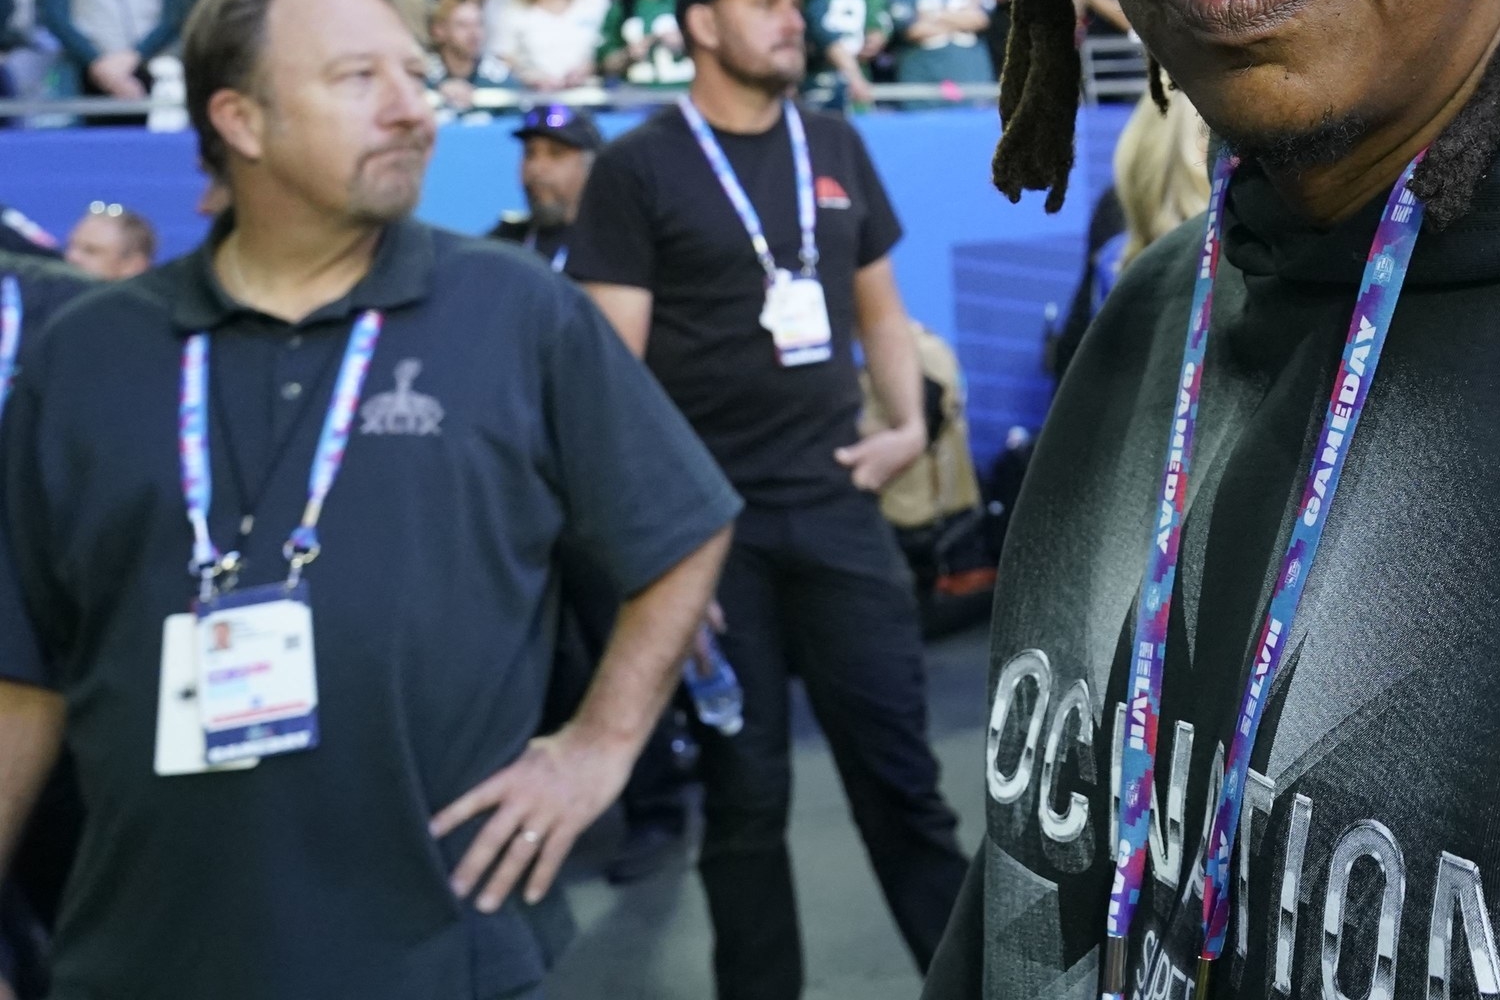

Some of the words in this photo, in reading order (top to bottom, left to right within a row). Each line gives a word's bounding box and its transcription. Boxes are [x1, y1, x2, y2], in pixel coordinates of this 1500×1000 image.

[1156, 361, 1196, 555] GAMEDAY
[1303, 314, 1378, 528] GAMEDAY
[1250, 618, 1283, 700] LVII
[1129, 676, 1150, 751] LVII
[1107, 838, 1131, 937] GAM
[1136, 929, 1196, 1000] SUPE
